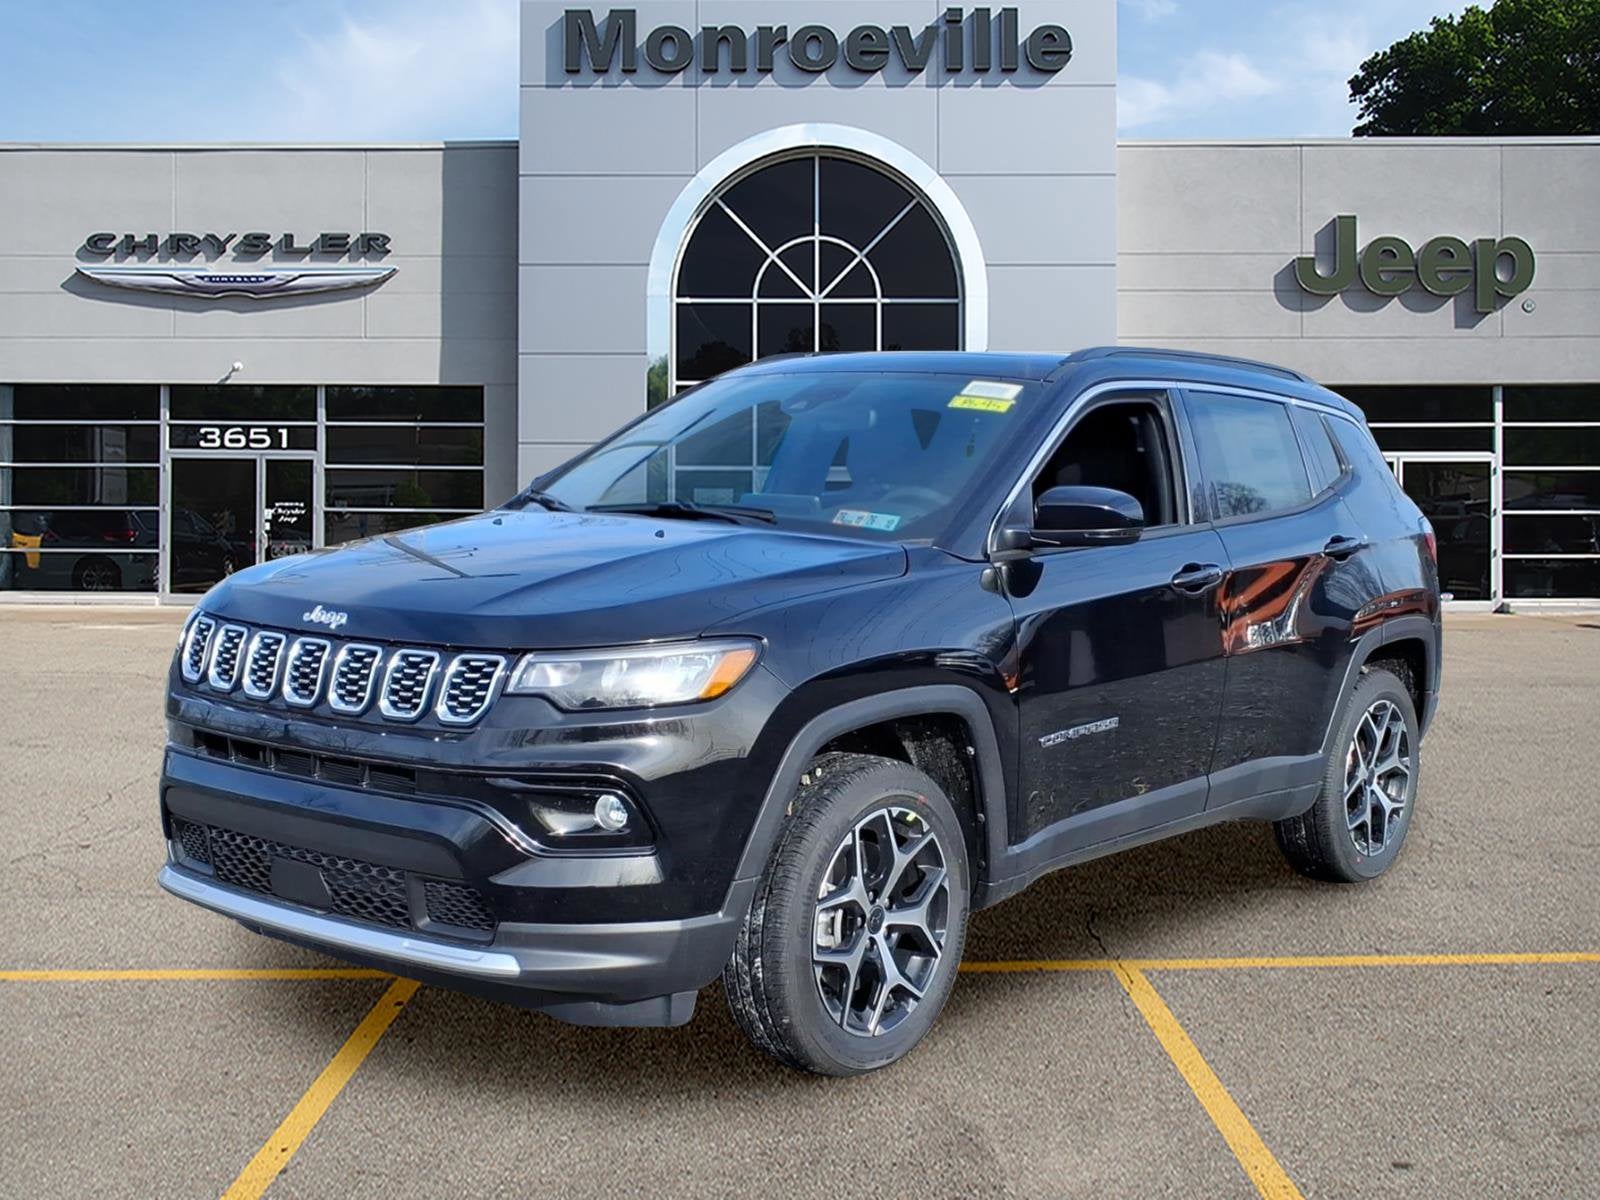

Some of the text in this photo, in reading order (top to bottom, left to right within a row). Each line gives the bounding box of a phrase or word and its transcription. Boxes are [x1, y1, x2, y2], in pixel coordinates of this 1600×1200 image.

[564, 7, 1074, 73] Monroeville
[86, 233, 392, 254] CHRYSLER
[1295, 215, 1536, 313] Jeep
[199, 427, 289, 449] 3651
[303, 605, 348, 630] Jeep
